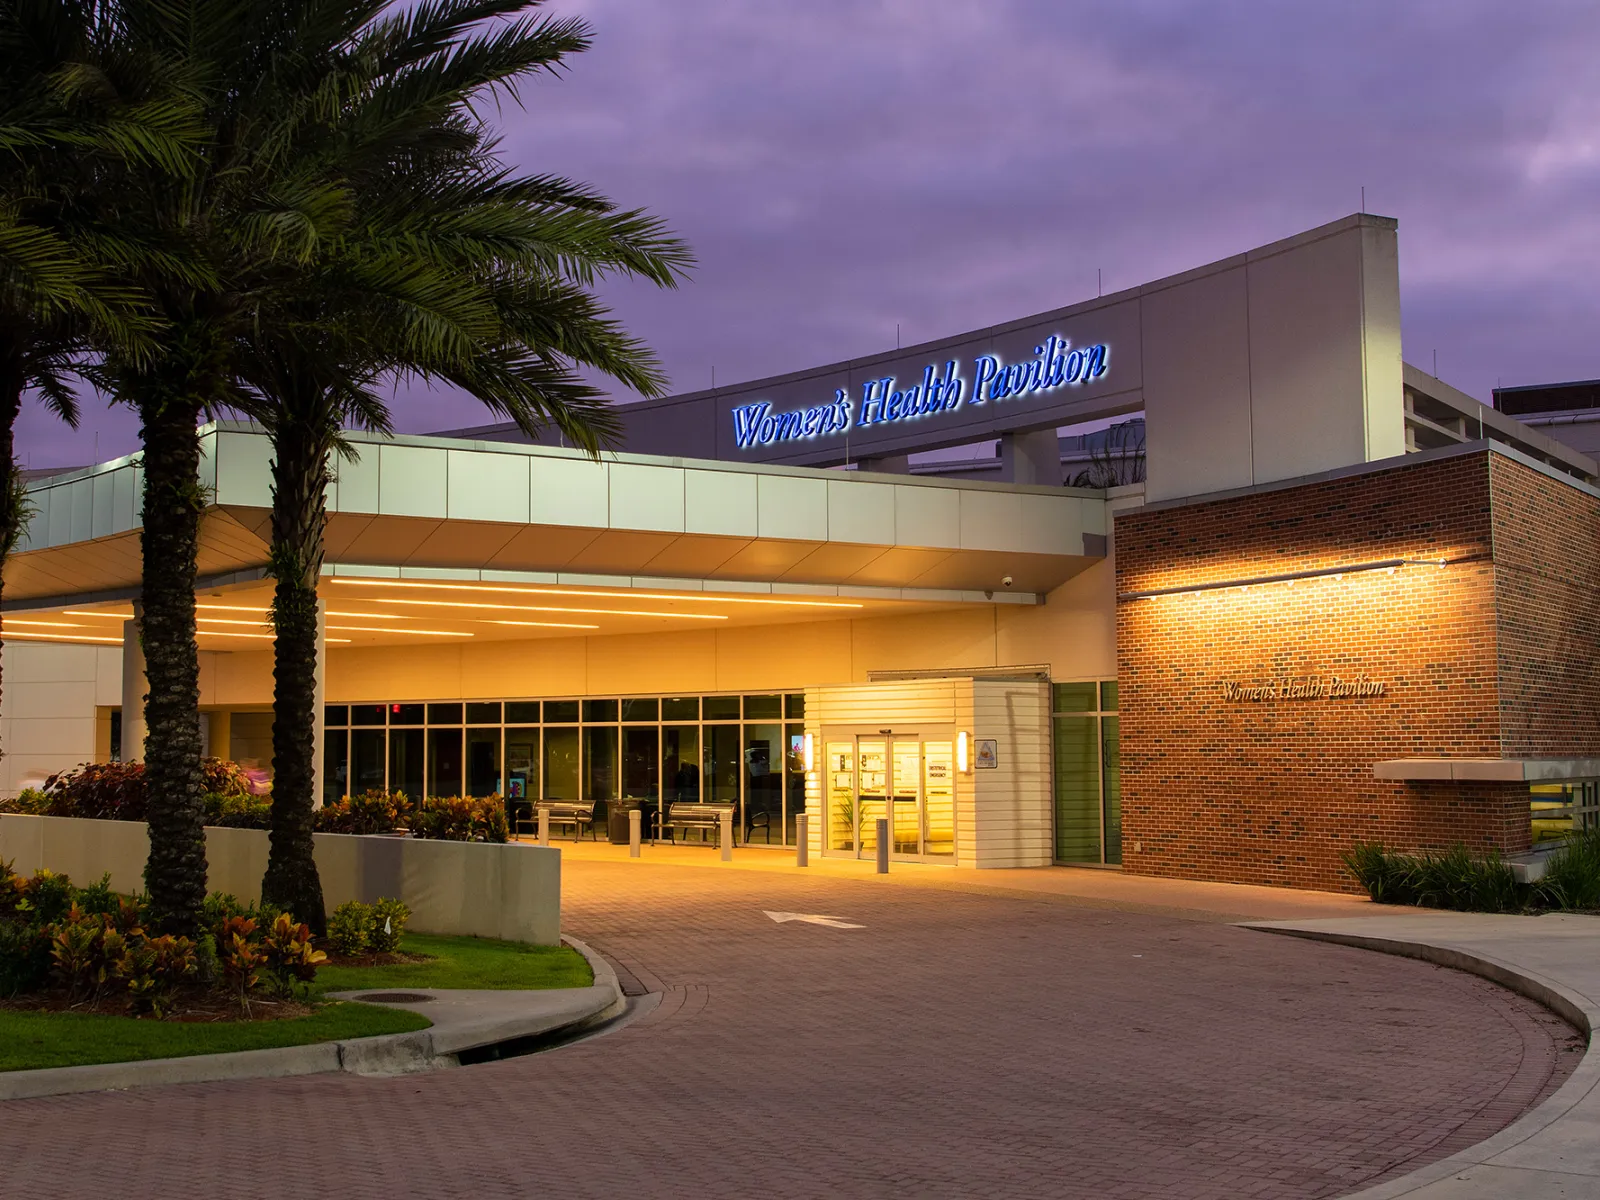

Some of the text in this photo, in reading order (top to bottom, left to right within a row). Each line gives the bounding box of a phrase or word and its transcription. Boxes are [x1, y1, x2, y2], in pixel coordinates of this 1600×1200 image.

[732, 335, 1107, 447] Women's Health Pavilion
[1223, 673, 1385, 700] Women's Health Pavilion
